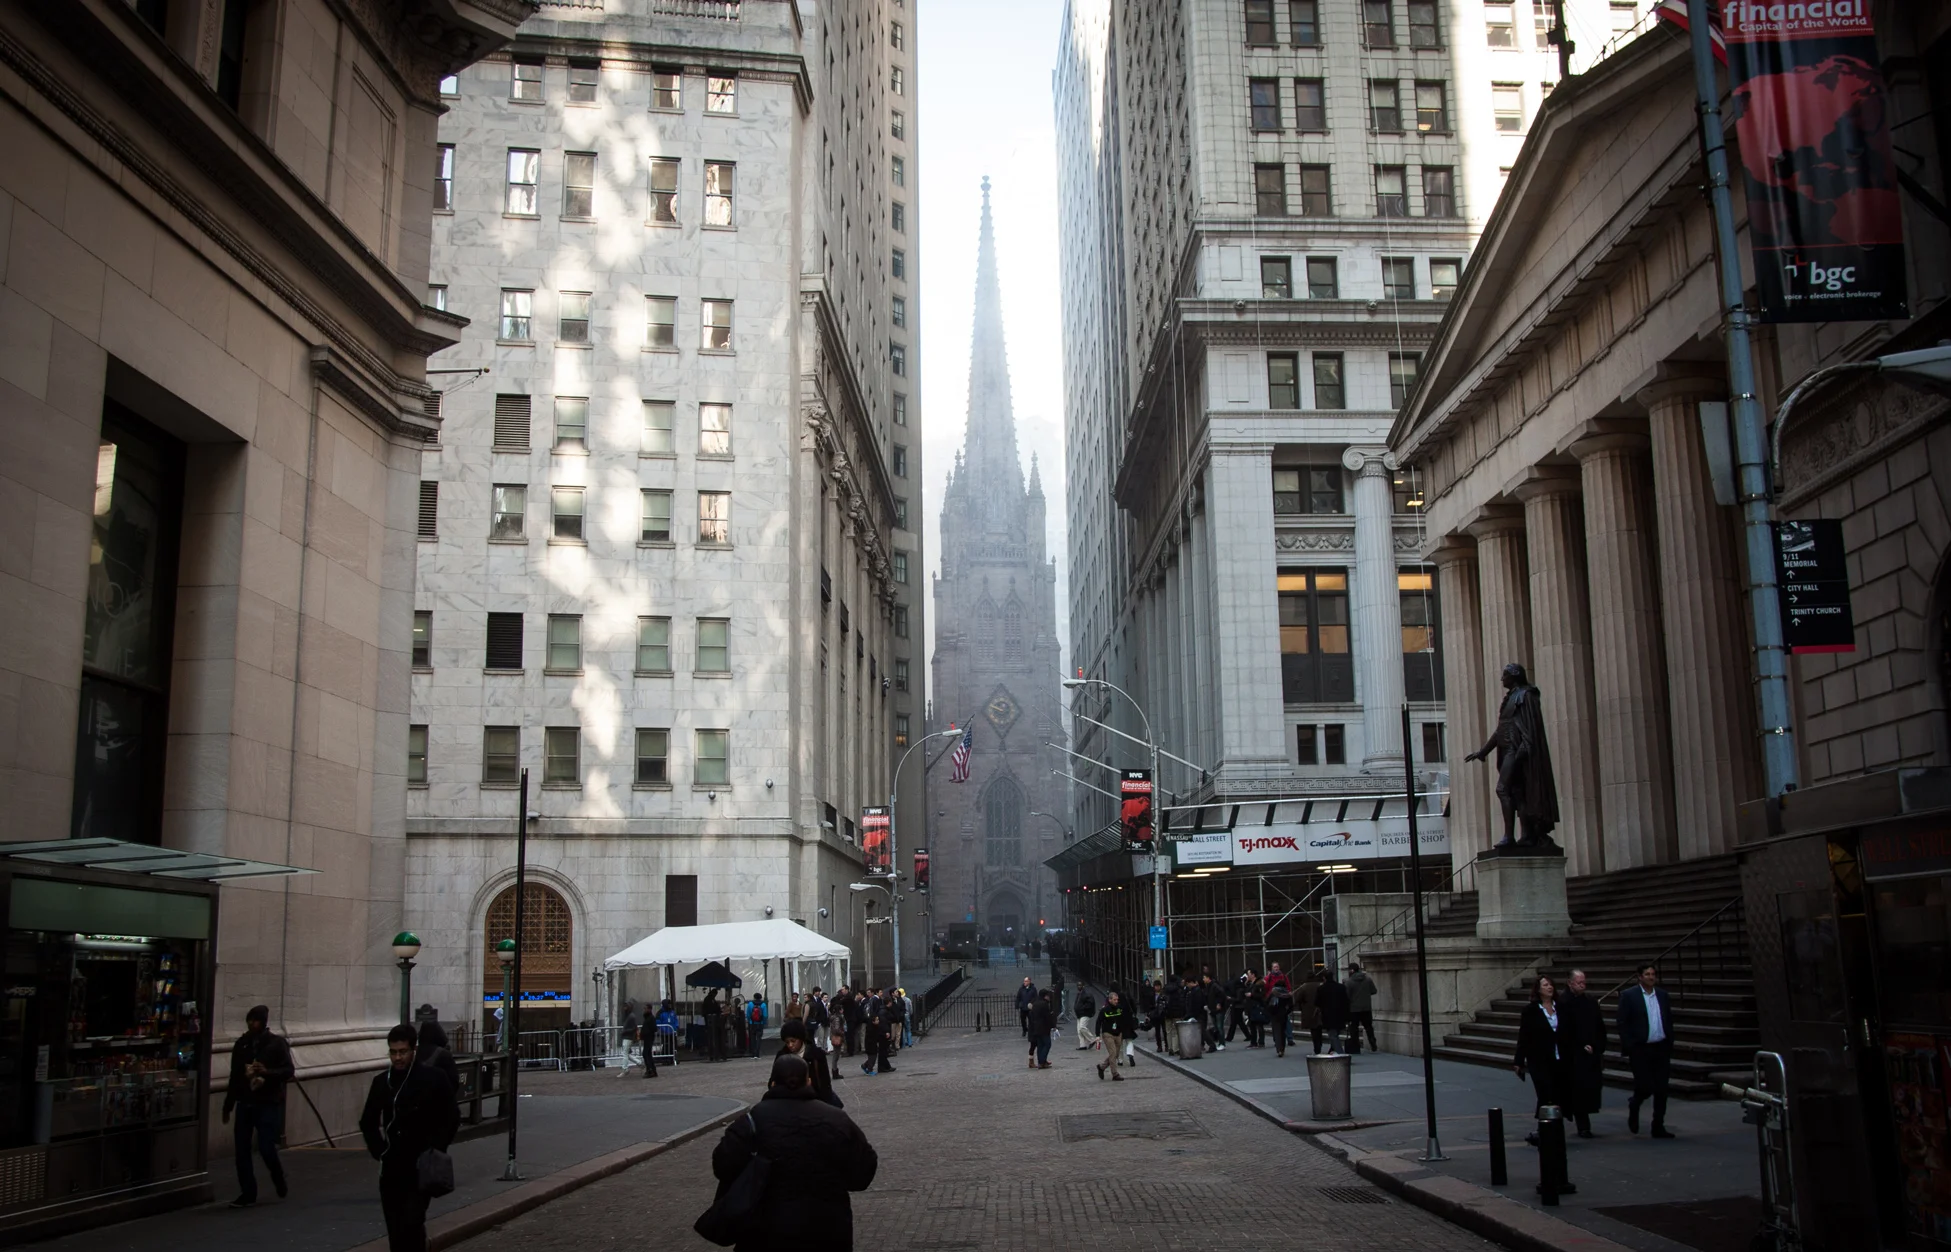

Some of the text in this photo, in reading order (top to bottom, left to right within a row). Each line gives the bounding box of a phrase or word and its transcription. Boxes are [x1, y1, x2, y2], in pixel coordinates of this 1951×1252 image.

[1723, 0, 1862, 28] financial
[1739, 17, 1867, 32] Capital of the World
[1810, 261, 1856, 290] bgc
[1381, 834, 1445, 845] BARBE SHOP
[1863, 835, 1906, 863] WALL
